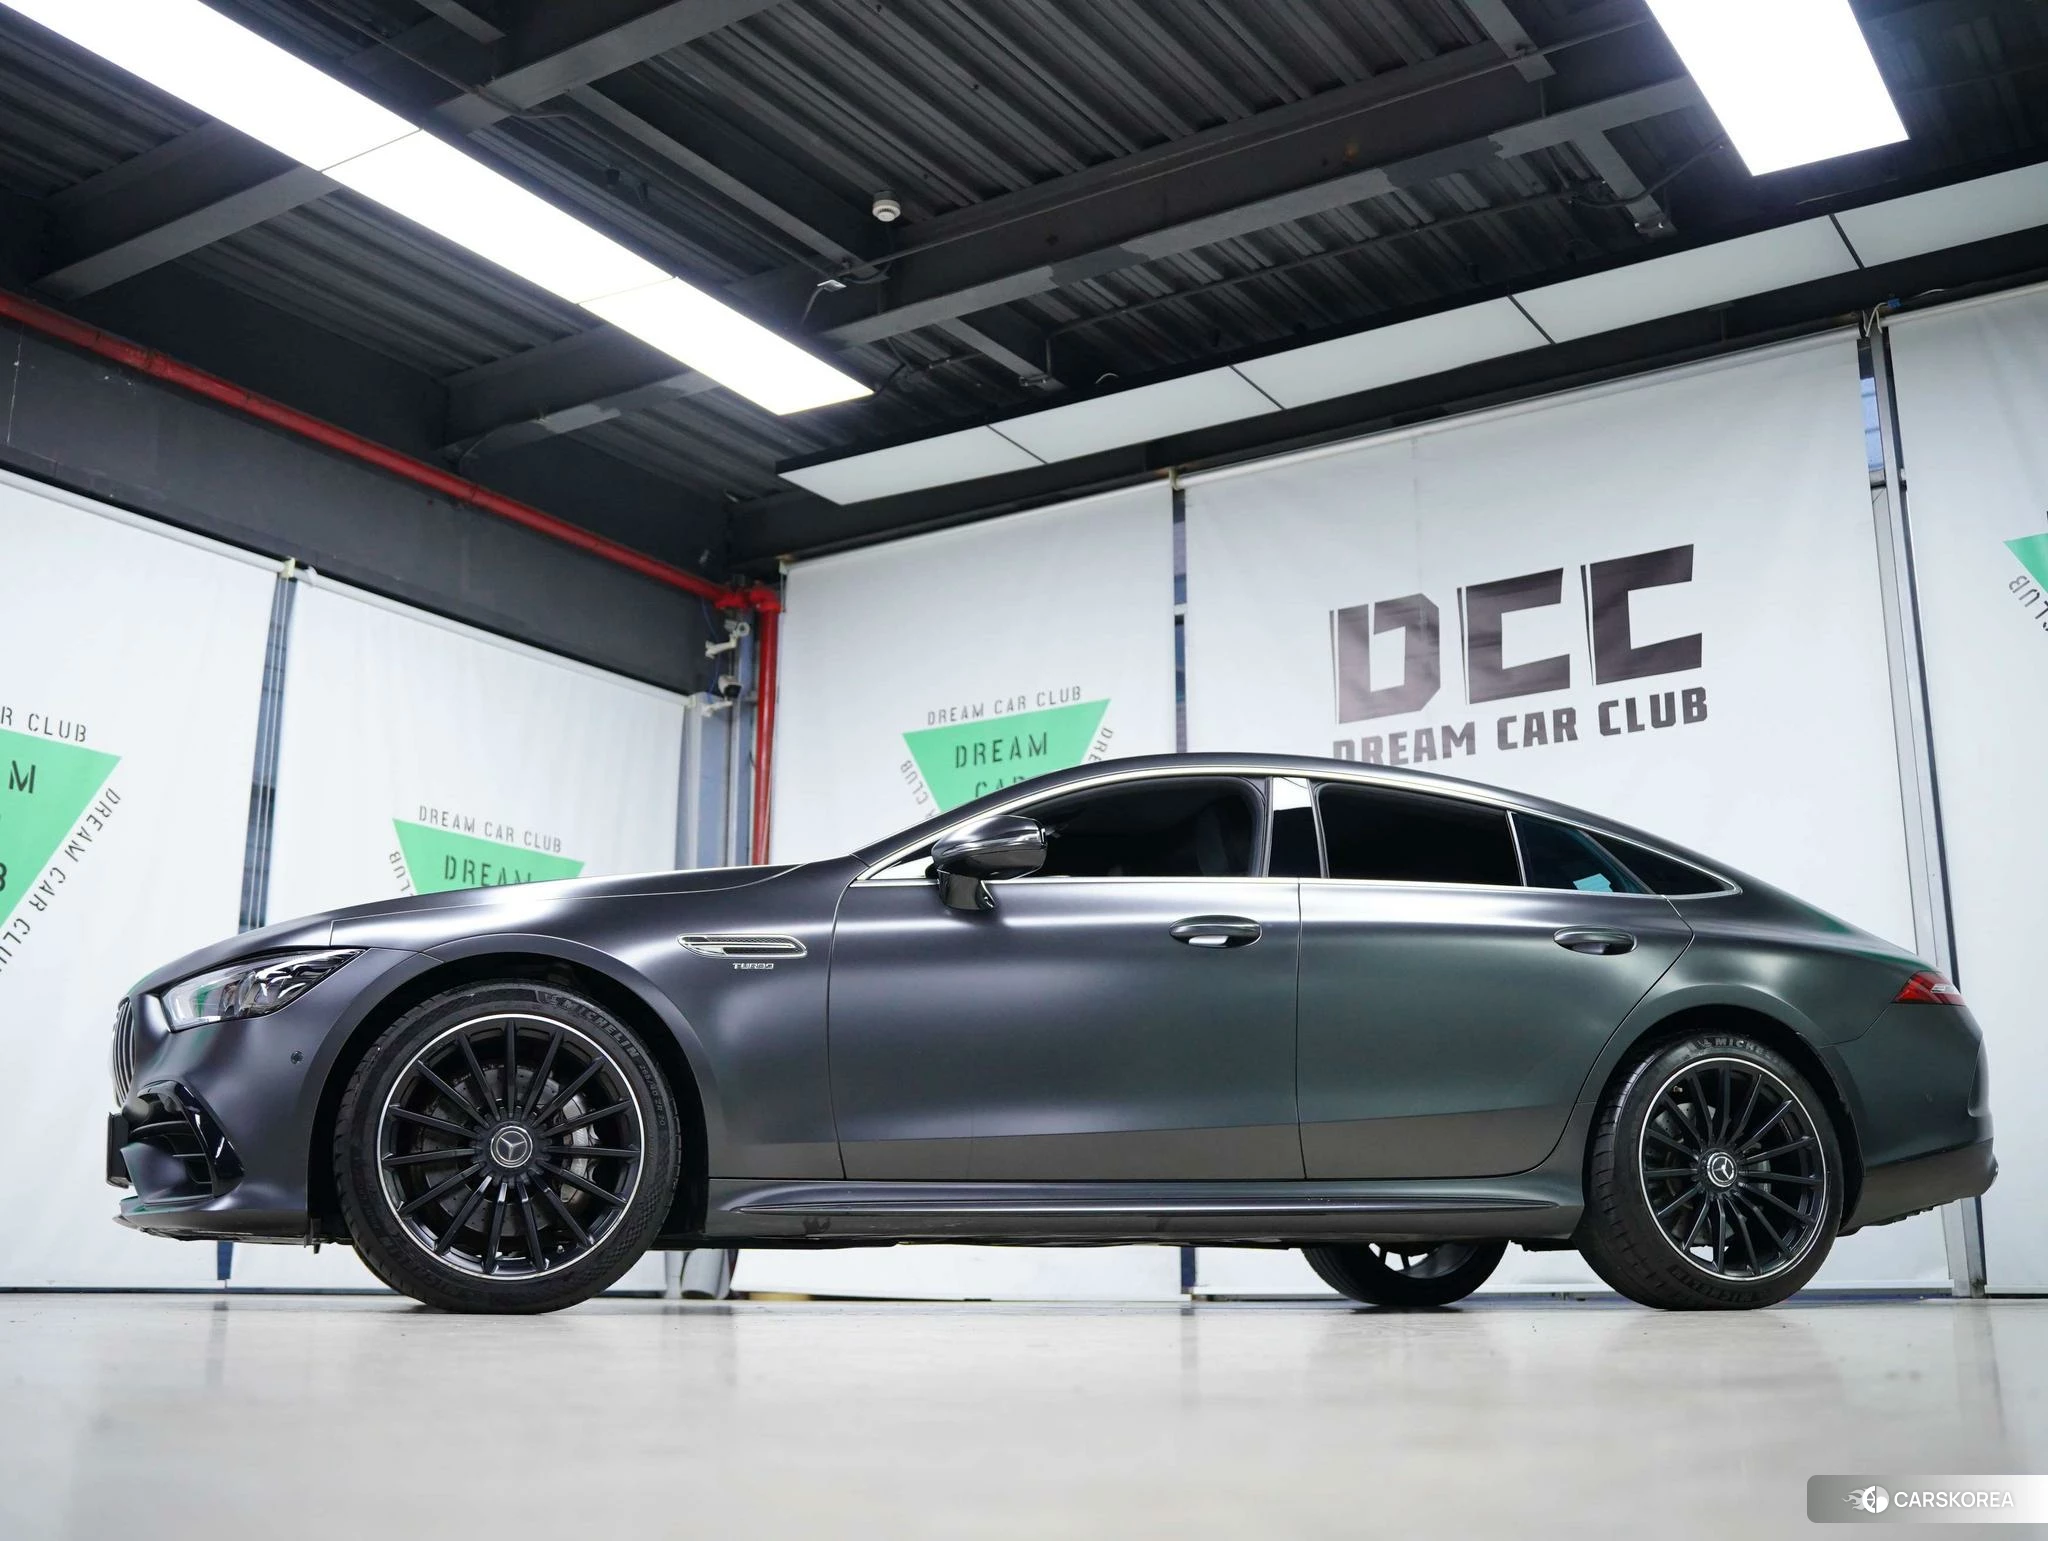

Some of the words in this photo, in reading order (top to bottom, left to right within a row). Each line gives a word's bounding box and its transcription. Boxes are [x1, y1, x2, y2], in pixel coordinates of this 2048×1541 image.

[2008, 575, 2048, 632] LUB
[28, 713, 87, 742] CLUB
[927, 703, 984, 726] DREAM
[994, 695, 1026, 715] CAR
[1036, 686, 1081, 707] CLUB
[1333, 721, 1476, 766] DREAM
[1497, 707, 1578, 751] CAR
[1598, 686, 1708, 737] CLUB
[955, 732, 1048, 769] DREAM
[1088, 727, 1113, 762] DRE
[900, 760, 928, 805] CLUB
[64, 788, 121, 862] DREAM
[418, 805, 475, 833] DREAM
[484, 821, 515, 843] CAR
[523, 831, 562, 853] CLUB
[28, 867, 66, 912] CAR
[389, 851, 414, 896] LUB
[732, 962, 774, 970] TURBO
[562, 999, 640, 1058] MICHELIN
